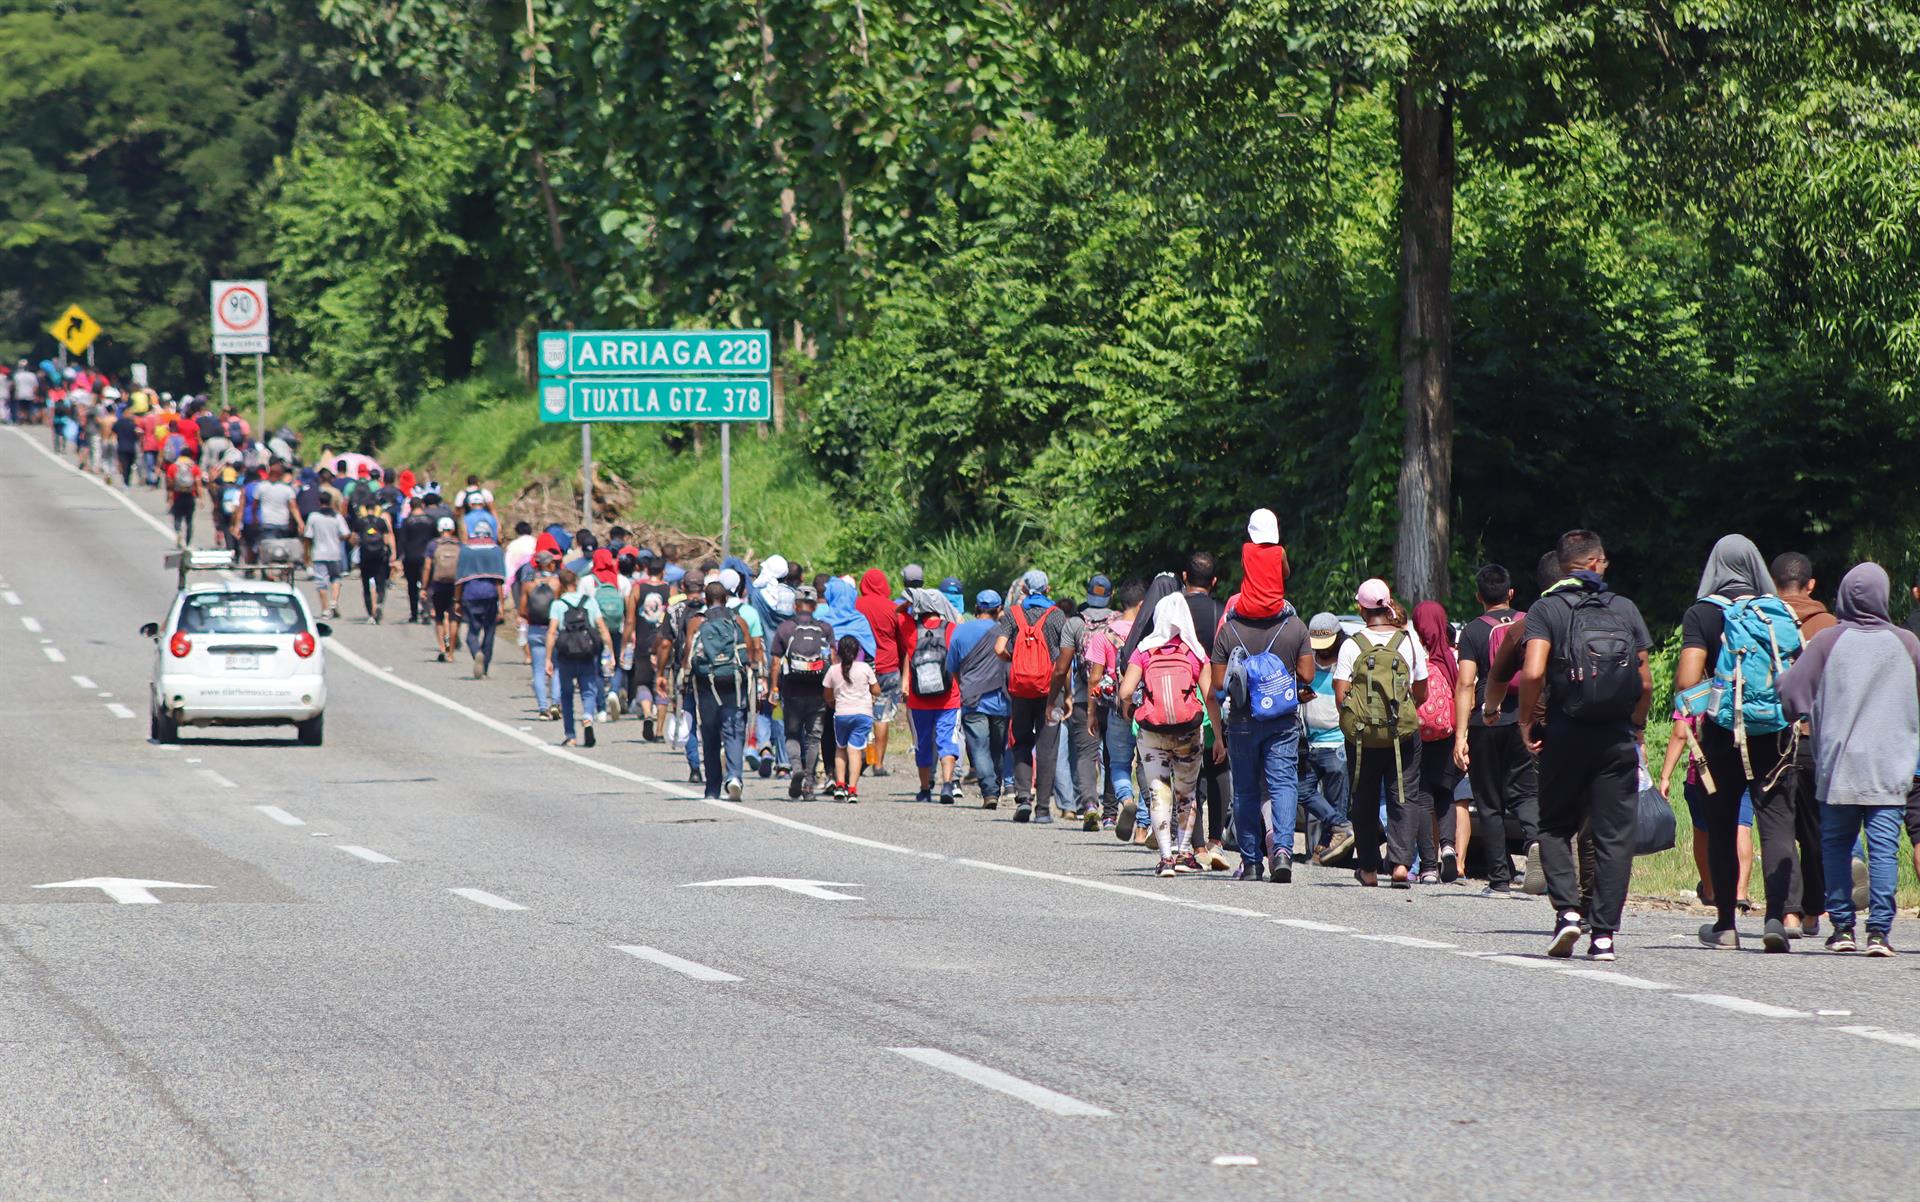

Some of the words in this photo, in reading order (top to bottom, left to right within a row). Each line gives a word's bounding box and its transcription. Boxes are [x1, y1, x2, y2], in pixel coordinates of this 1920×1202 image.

[230, 294, 251, 314] 90
[578, 340, 713, 366] ARRIAGA
[719, 339, 762, 365] 228
[581, 387, 660, 412] TUXTLA
[669, 387, 712, 412] GTZ.
[723, 387, 761, 412] 378
